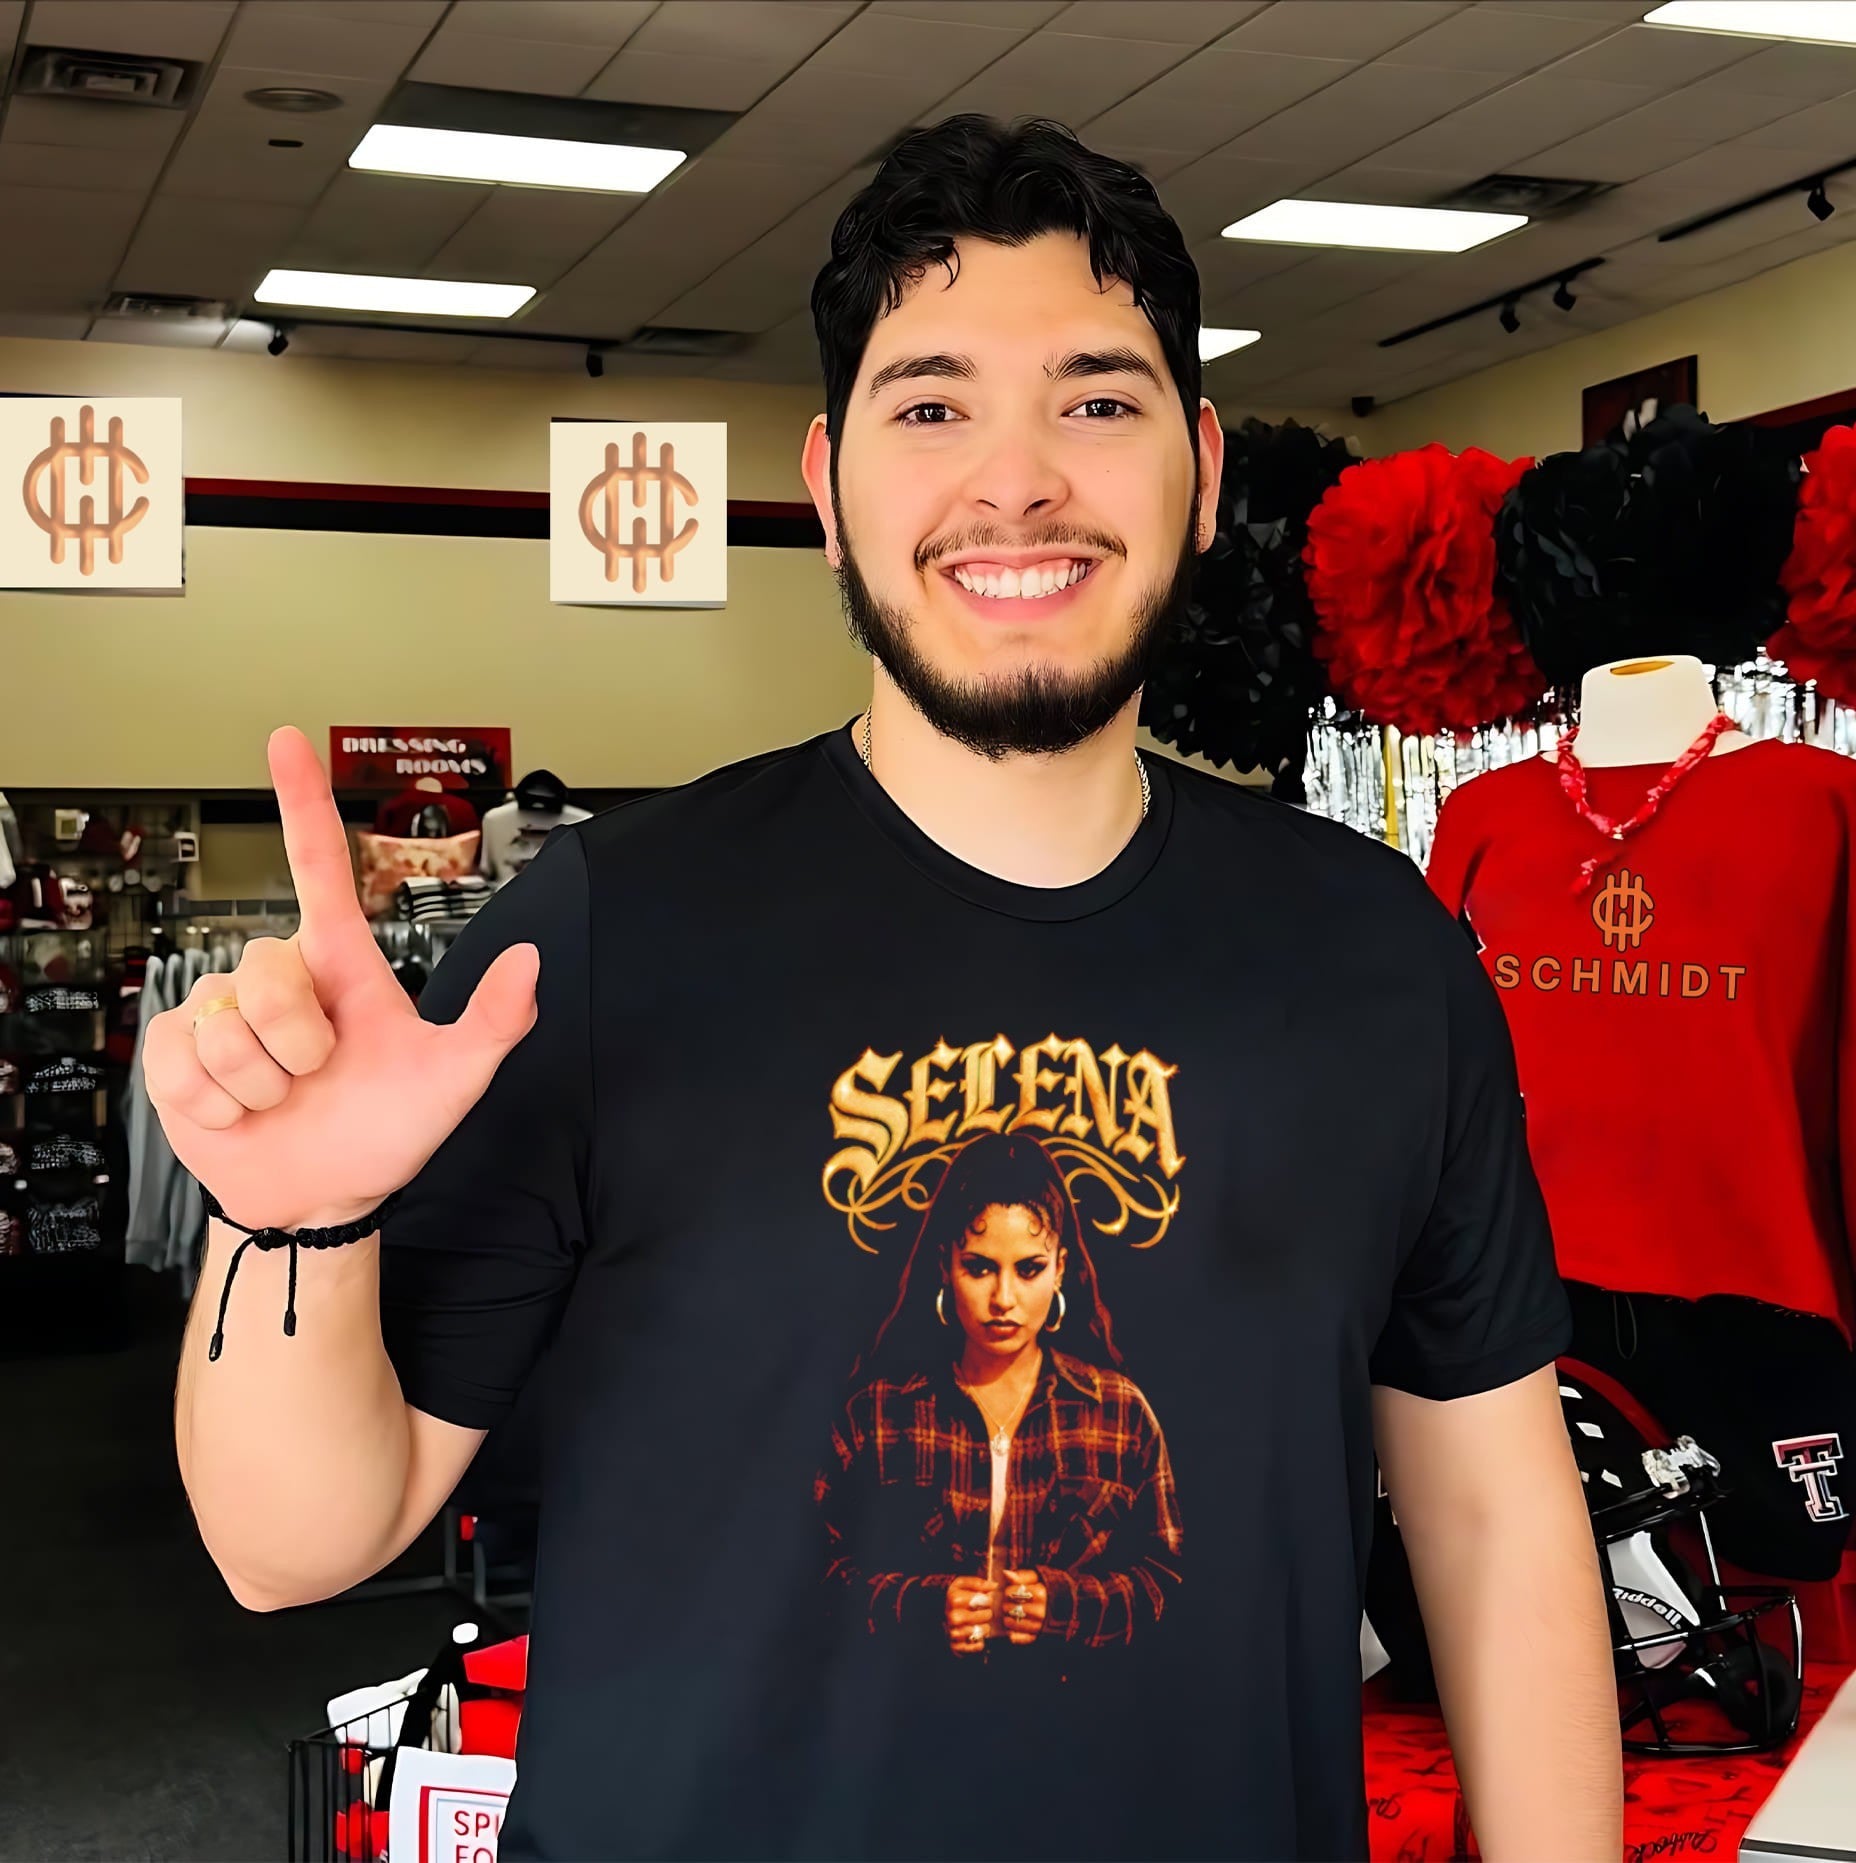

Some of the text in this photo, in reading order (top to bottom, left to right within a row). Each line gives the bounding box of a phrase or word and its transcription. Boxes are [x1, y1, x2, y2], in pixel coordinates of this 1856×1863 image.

[396, 758, 487, 774] ROOMS
[1494, 954, 1747, 1000] SCHMIDT
[822, 1032, 1186, 1191] SELENA
